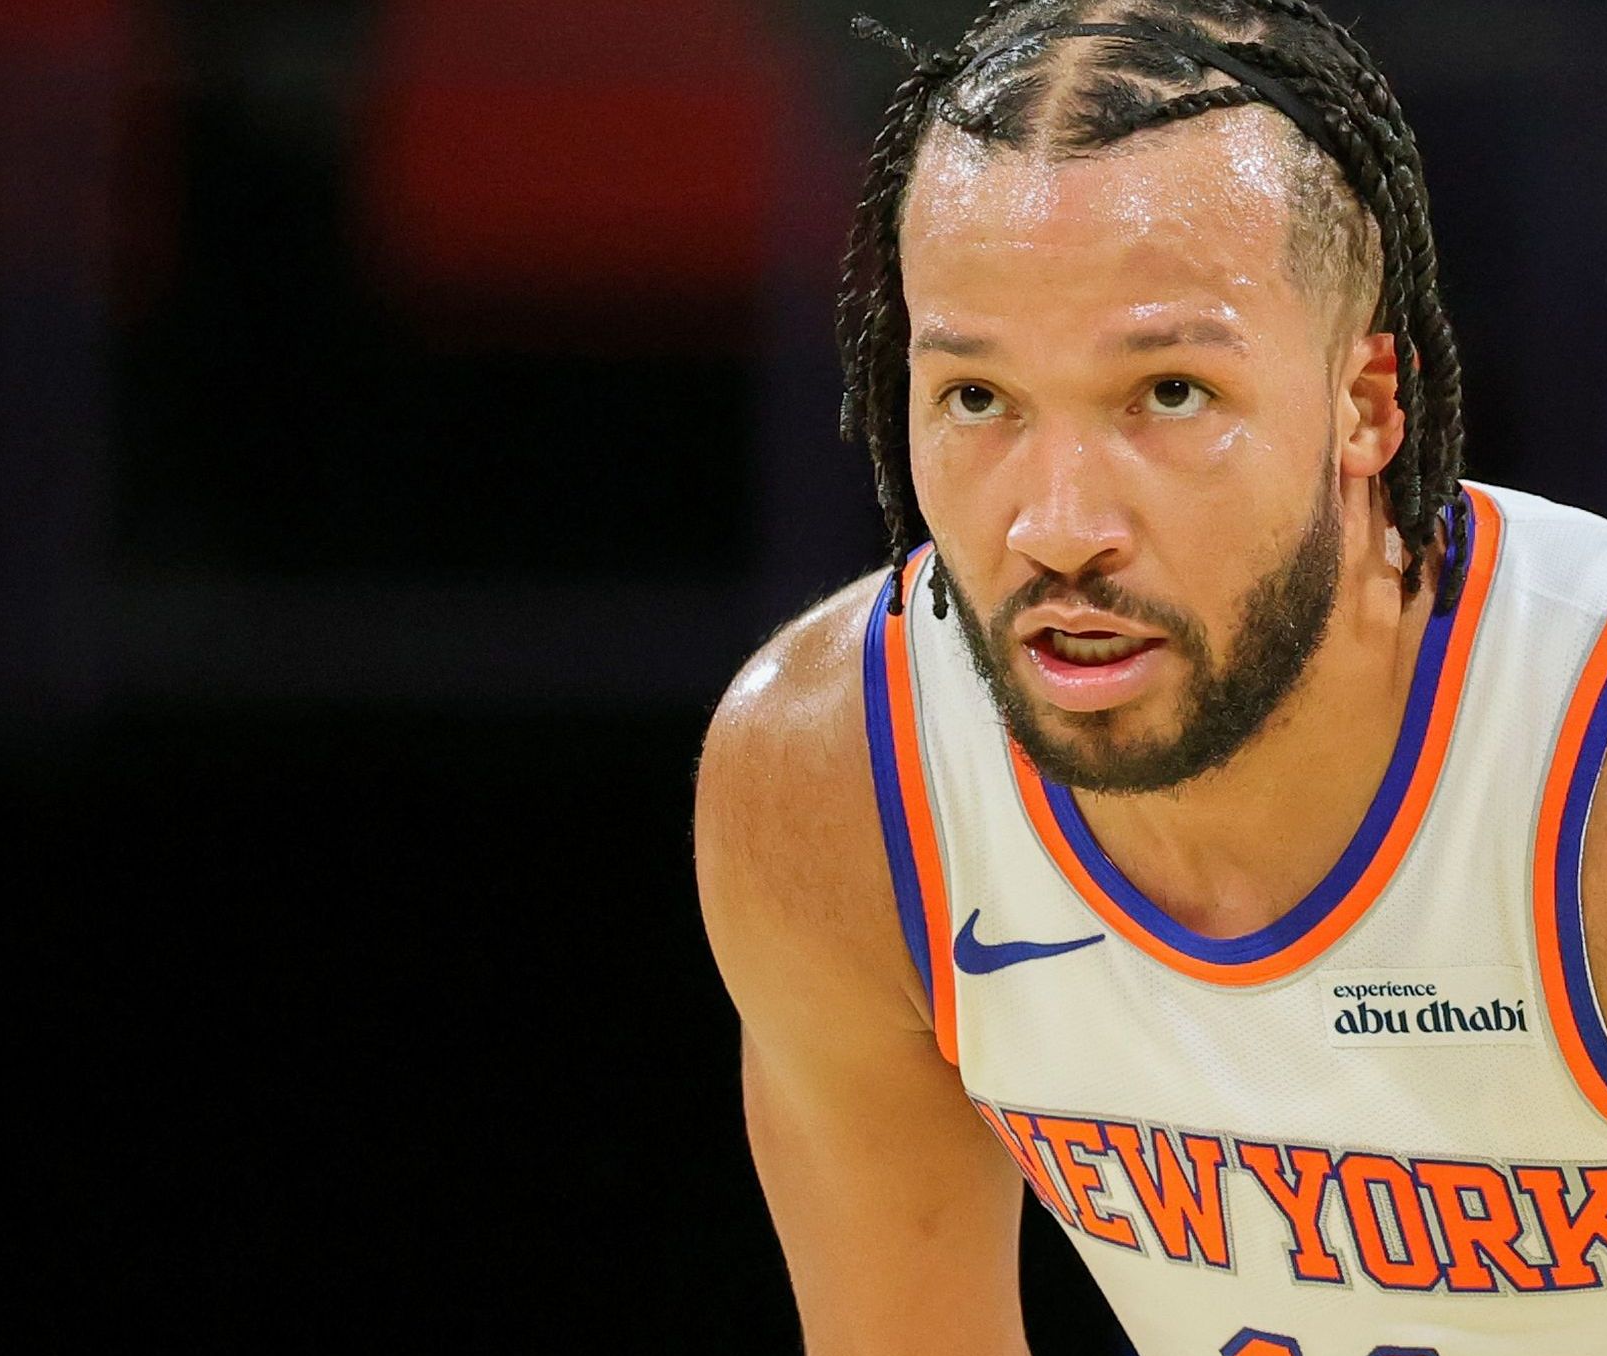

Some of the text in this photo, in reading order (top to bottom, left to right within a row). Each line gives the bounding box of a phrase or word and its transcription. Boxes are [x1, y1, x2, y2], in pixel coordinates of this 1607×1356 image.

[1333, 981, 1437, 1001] experience
[1334, 998, 1529, 1035] abu dhabi
[968, 1093, 1234, 1272] NEW
